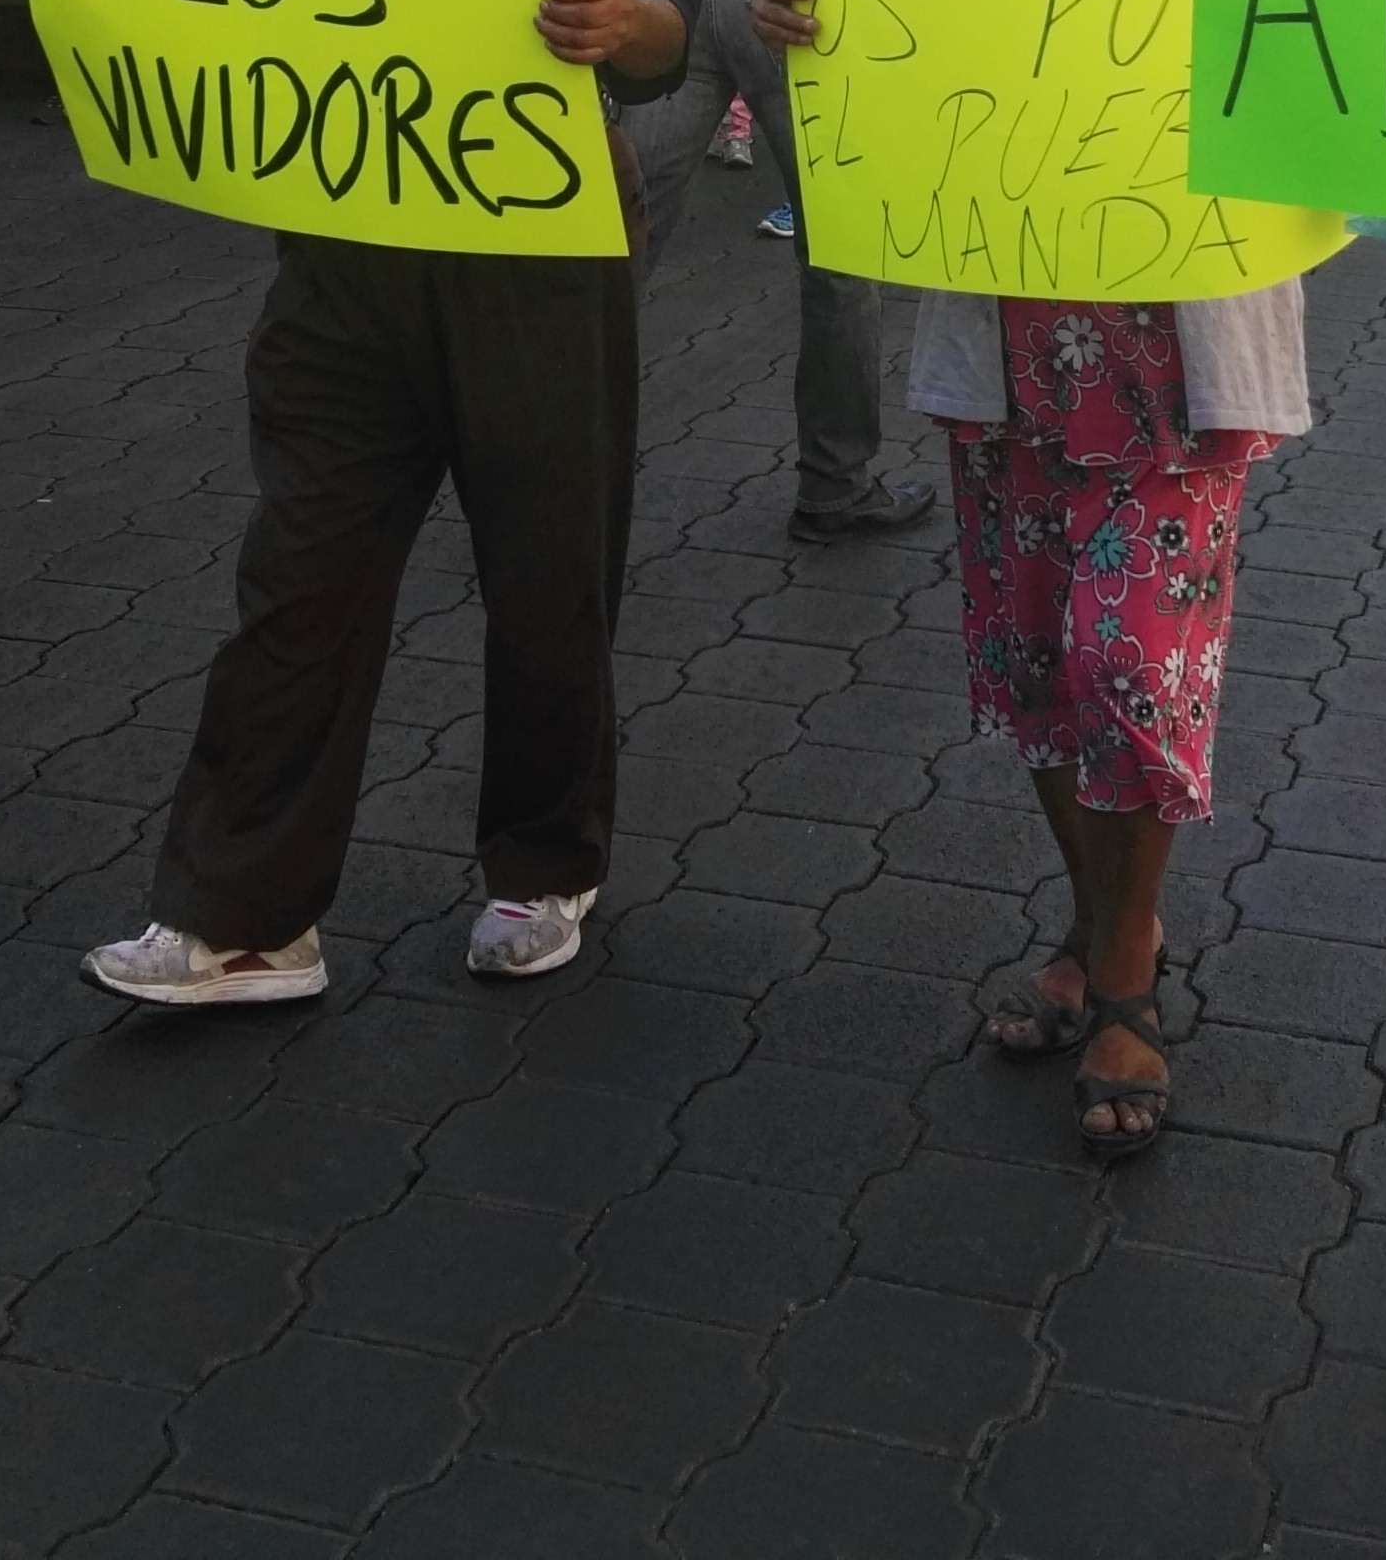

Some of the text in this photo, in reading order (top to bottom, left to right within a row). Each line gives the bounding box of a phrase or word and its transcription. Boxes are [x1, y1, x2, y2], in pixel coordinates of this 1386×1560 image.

[72, 44, 581, 216] VIVIDORES
[795, 75, 863, 177] EL
[882, 189, 1249, 291] MANDA
